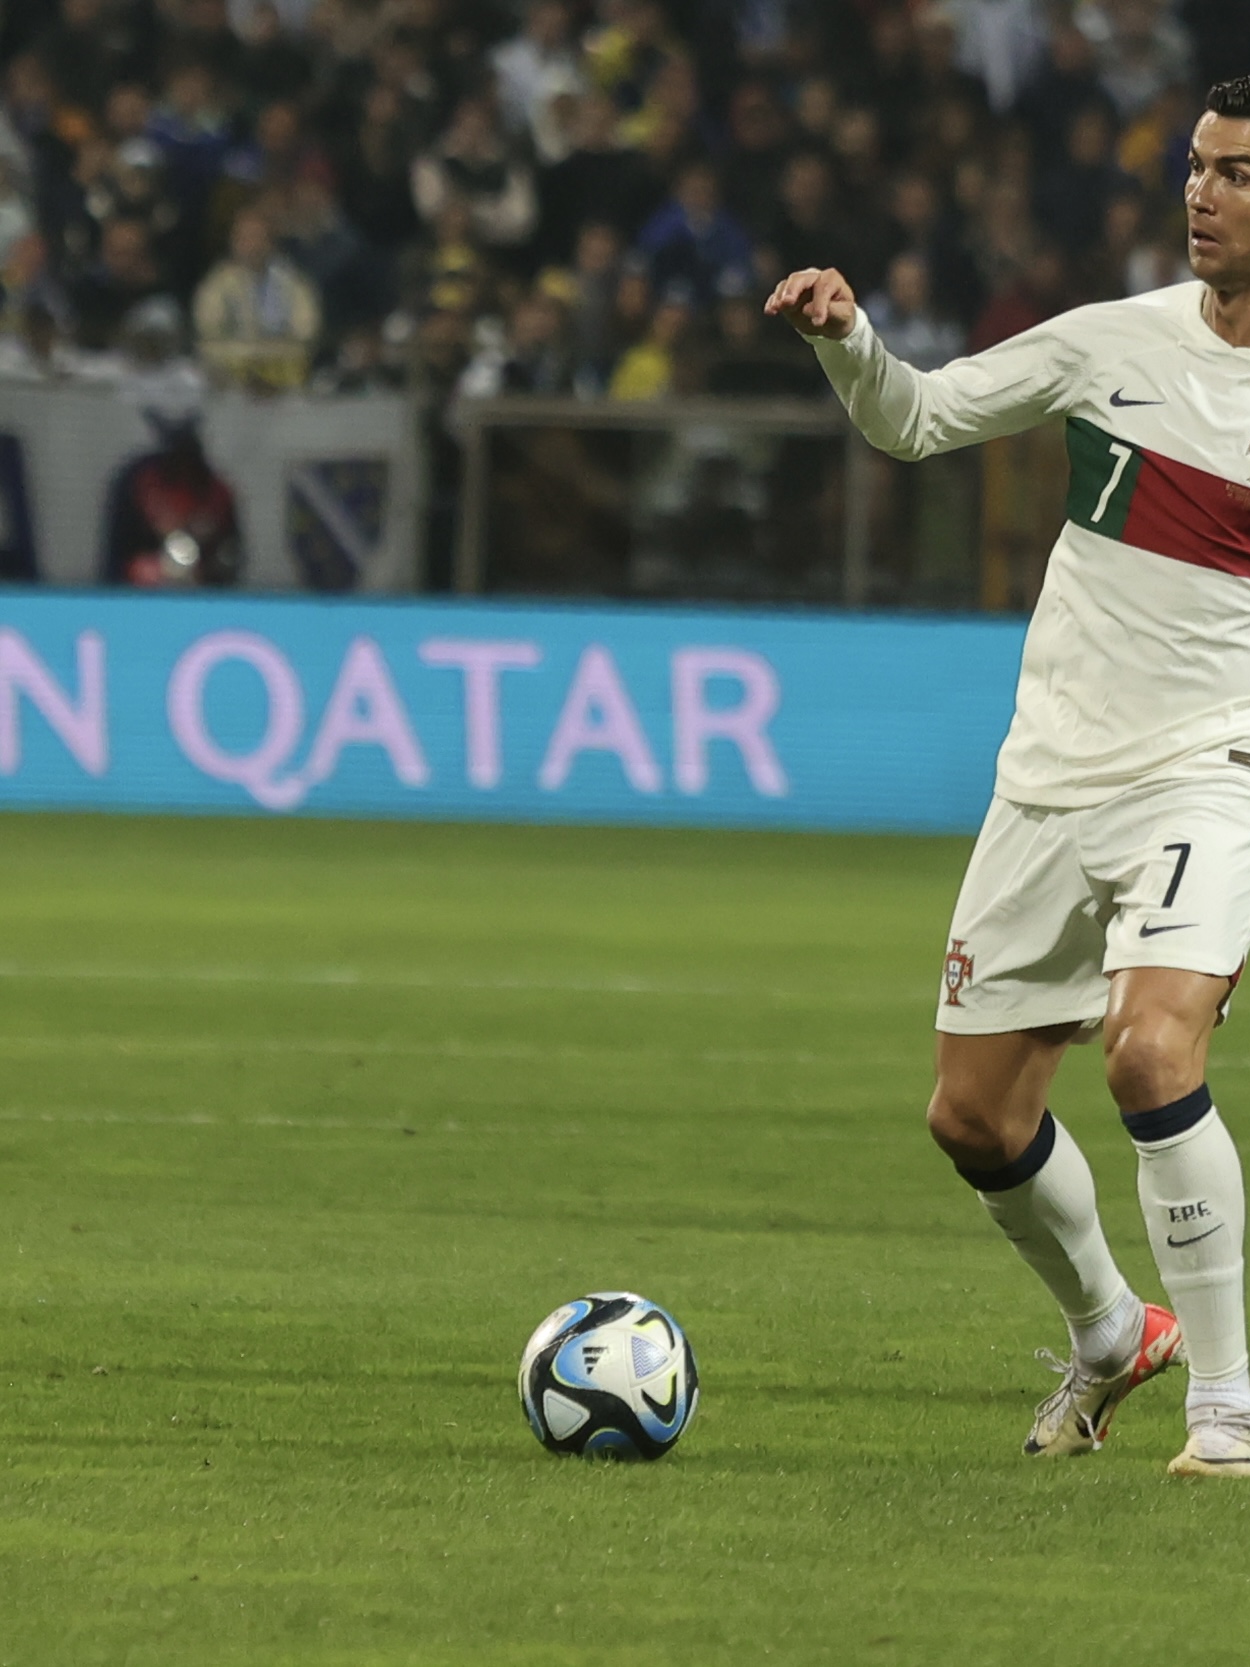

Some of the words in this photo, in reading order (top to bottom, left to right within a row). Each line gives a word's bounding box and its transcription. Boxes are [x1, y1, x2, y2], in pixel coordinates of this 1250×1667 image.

[1090, 442, 1133, 523] 7
[165, 630, 788, 810] QATAR
[1162, 842, 1192, 909] 7
